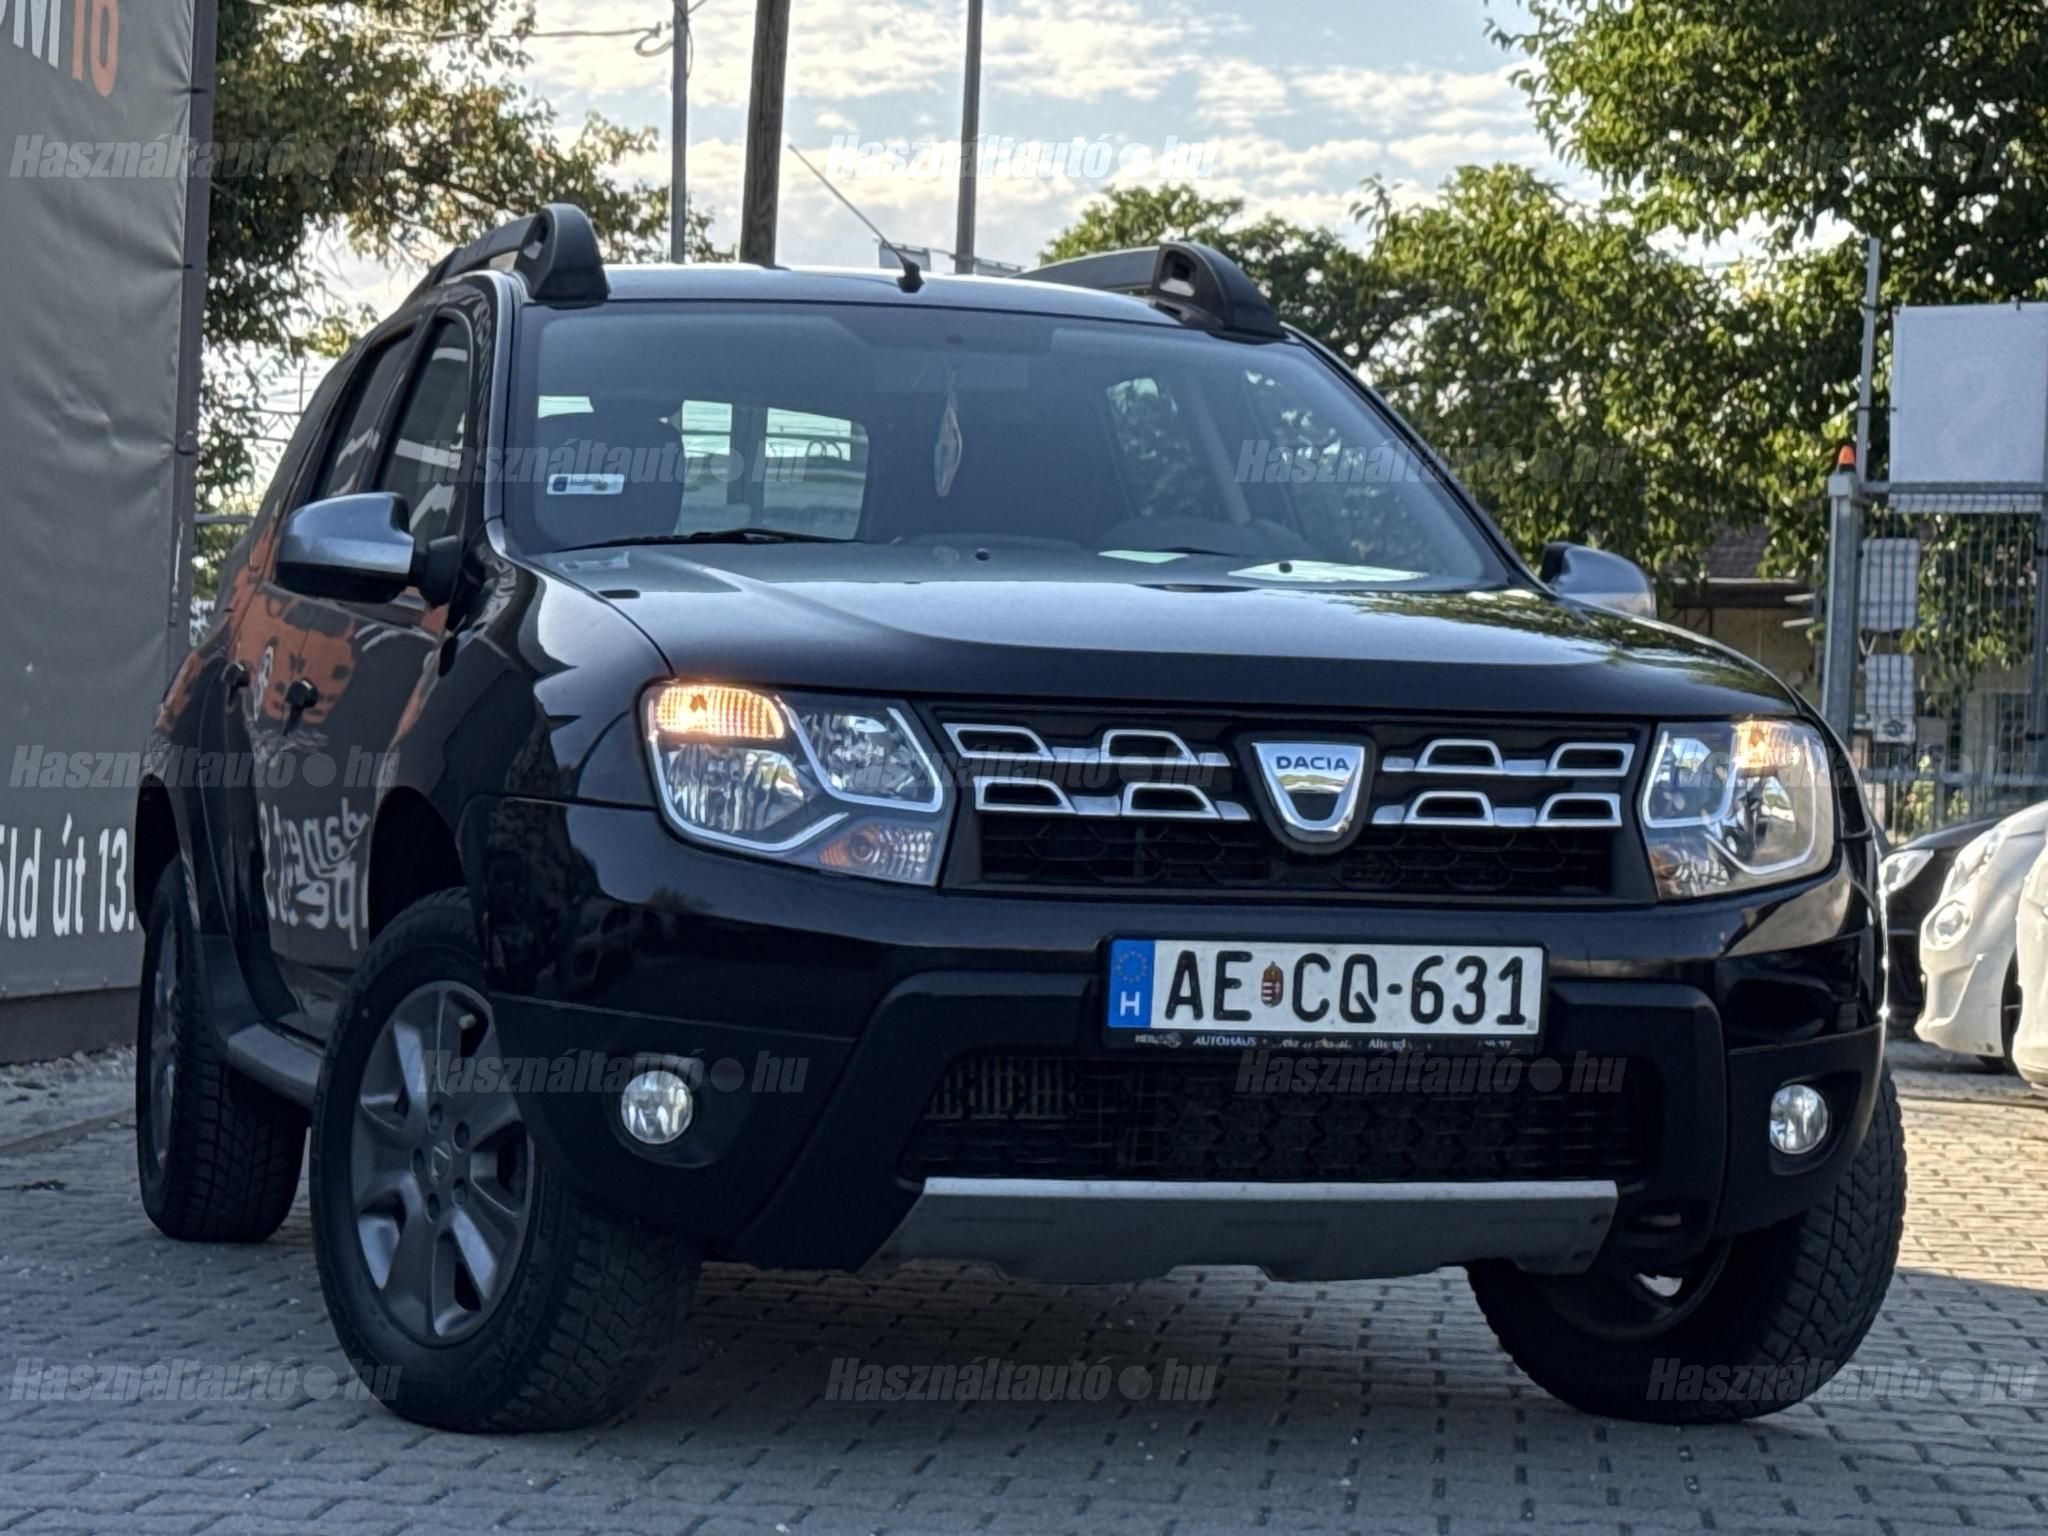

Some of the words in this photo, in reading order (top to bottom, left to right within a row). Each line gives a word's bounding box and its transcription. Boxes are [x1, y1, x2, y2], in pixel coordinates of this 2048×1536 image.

[1275, 756, 1350, 771] DACIA
[53, 812, 86, 937] út
[99, 827, 135, 933] 13.
[1119, 990, 1141, 1017] H
[1192, 1035, 1258, 1048] AUTOHAUS
